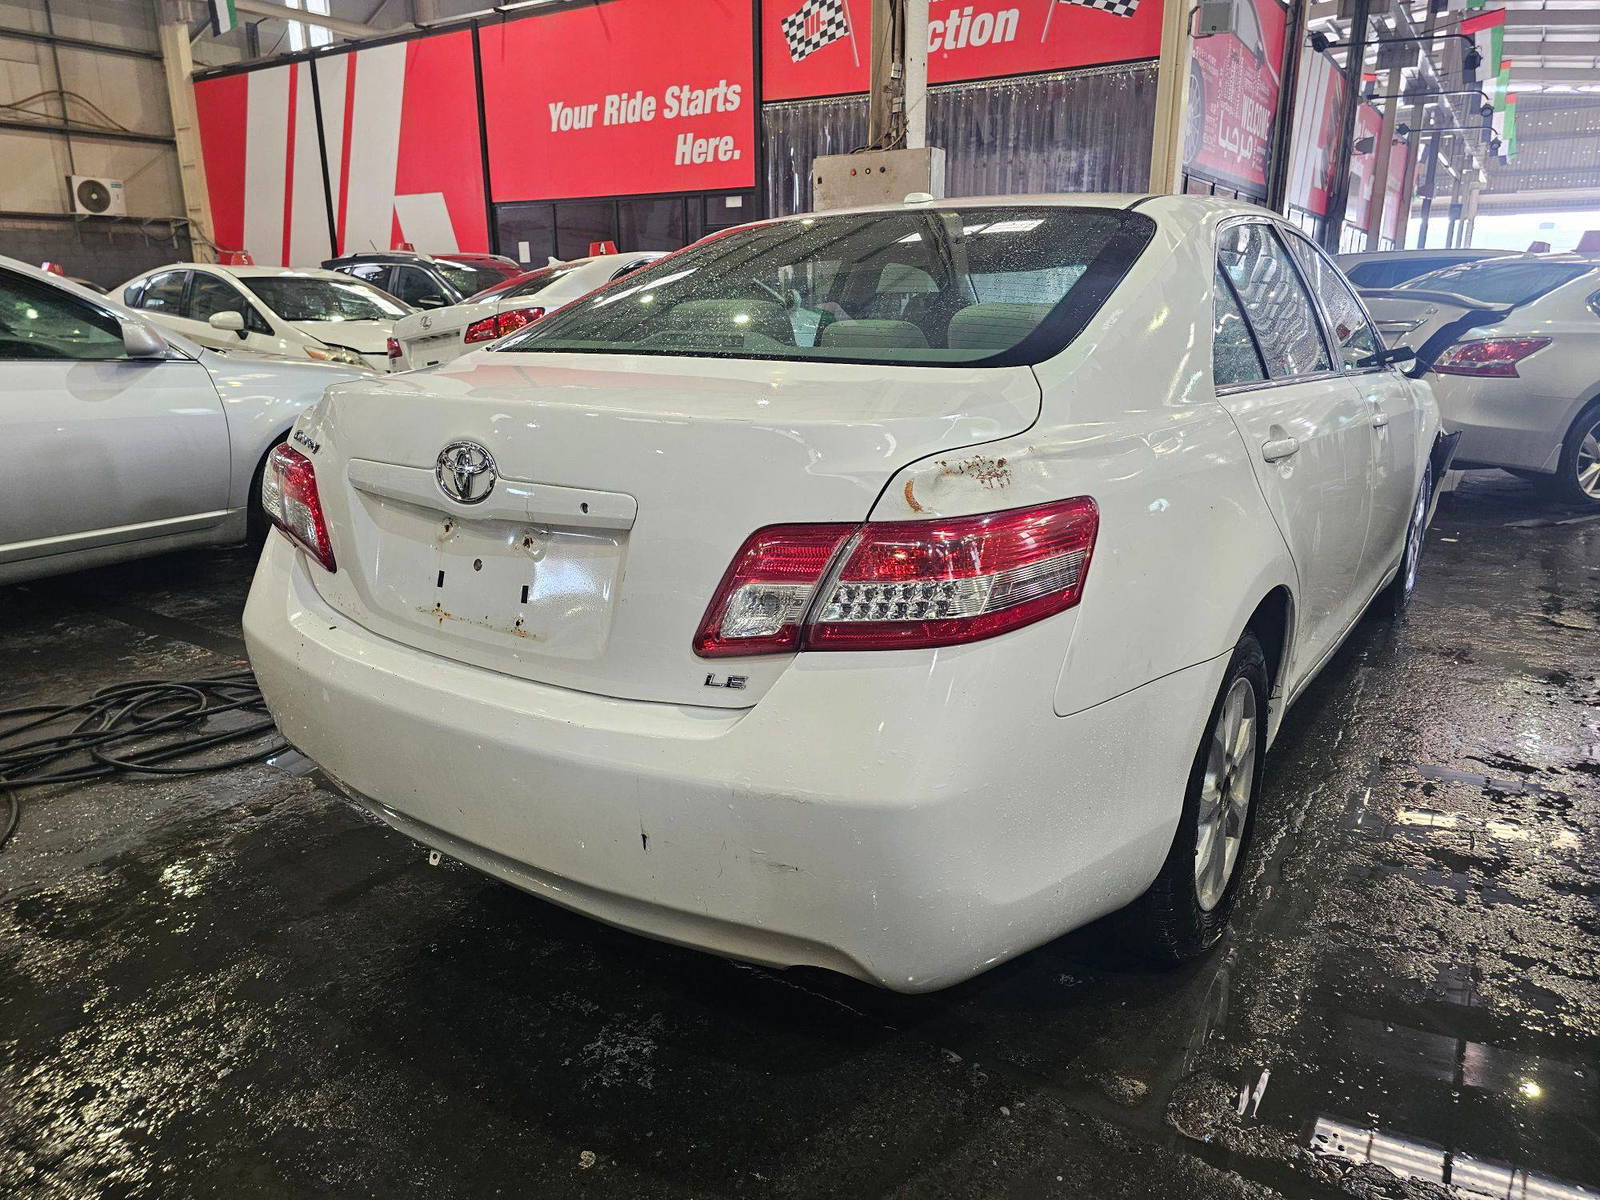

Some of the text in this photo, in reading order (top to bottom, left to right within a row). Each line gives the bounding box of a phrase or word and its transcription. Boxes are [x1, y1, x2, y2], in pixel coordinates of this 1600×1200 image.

[548, 79, 742, 132] Your Ride Starts
[1241, 94, 1271, 141] WELCOME
[674, 132, 742, 165] Here.
[1218, 110, 1253, 163] مرحبا
[704, 672, 749, 690] LE
